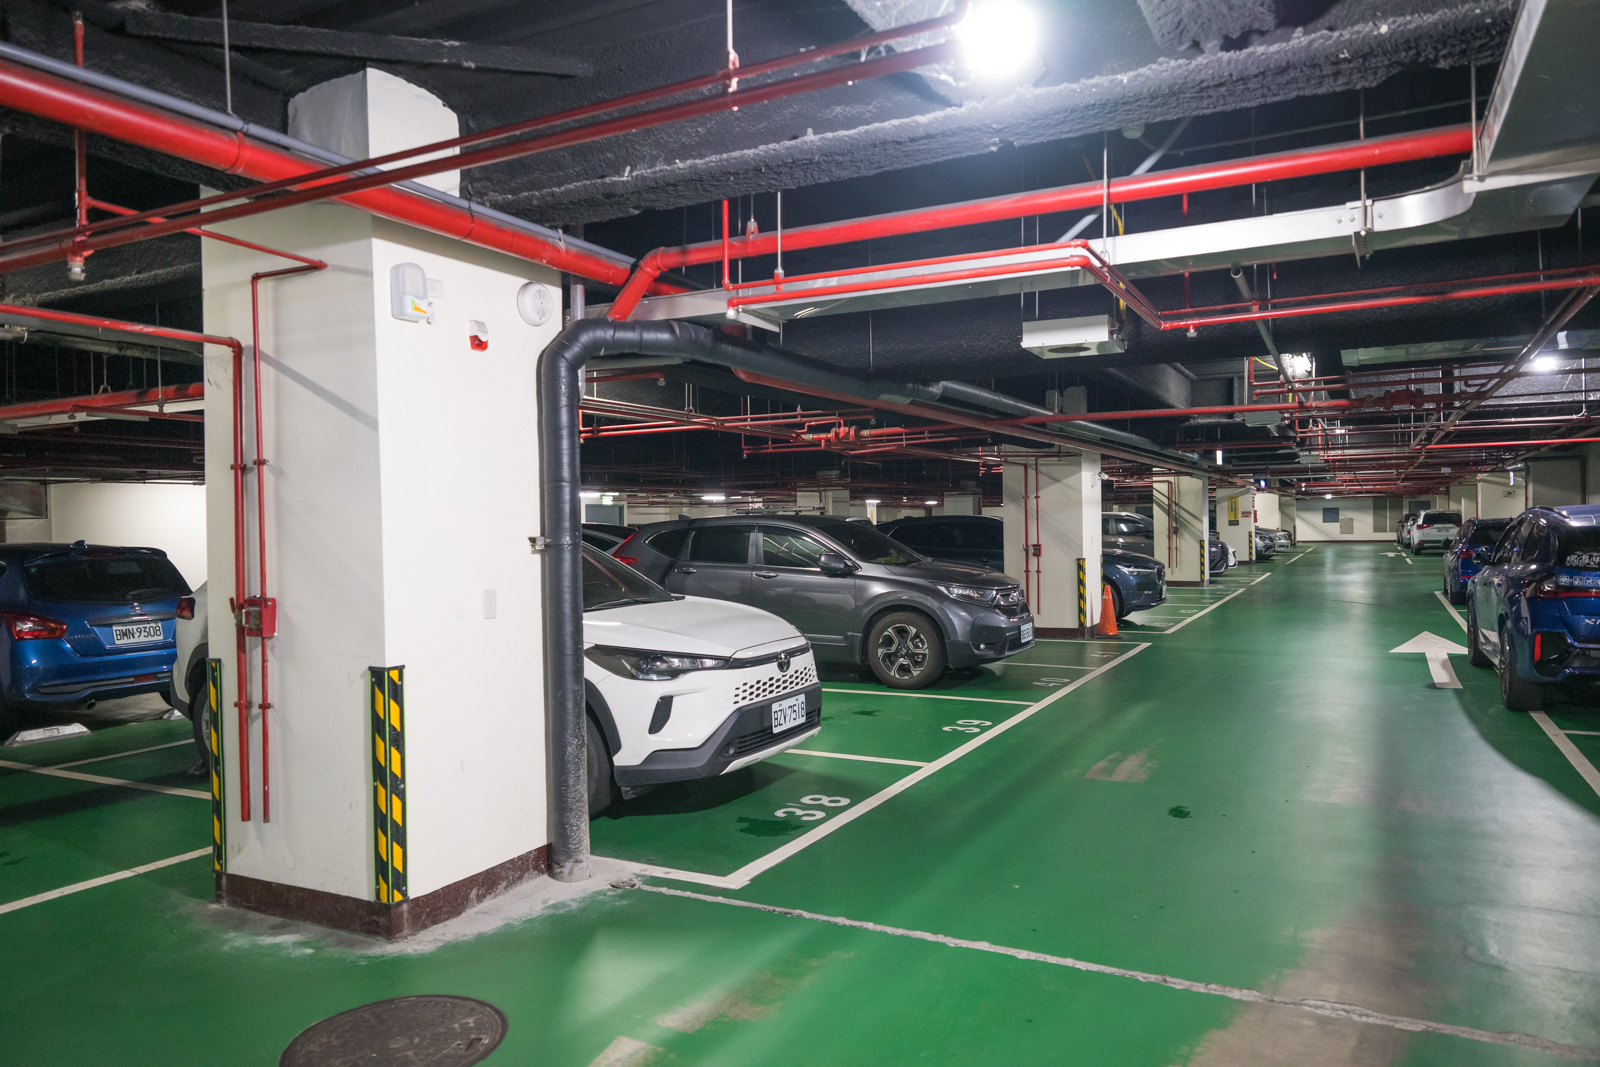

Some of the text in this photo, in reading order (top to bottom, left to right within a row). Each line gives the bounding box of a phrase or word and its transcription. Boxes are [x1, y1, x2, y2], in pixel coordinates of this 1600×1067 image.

[1032, 677, 1071, 687] 40
[942, 719, 993, 734] 39
[774, 794, 851, 821] 38
